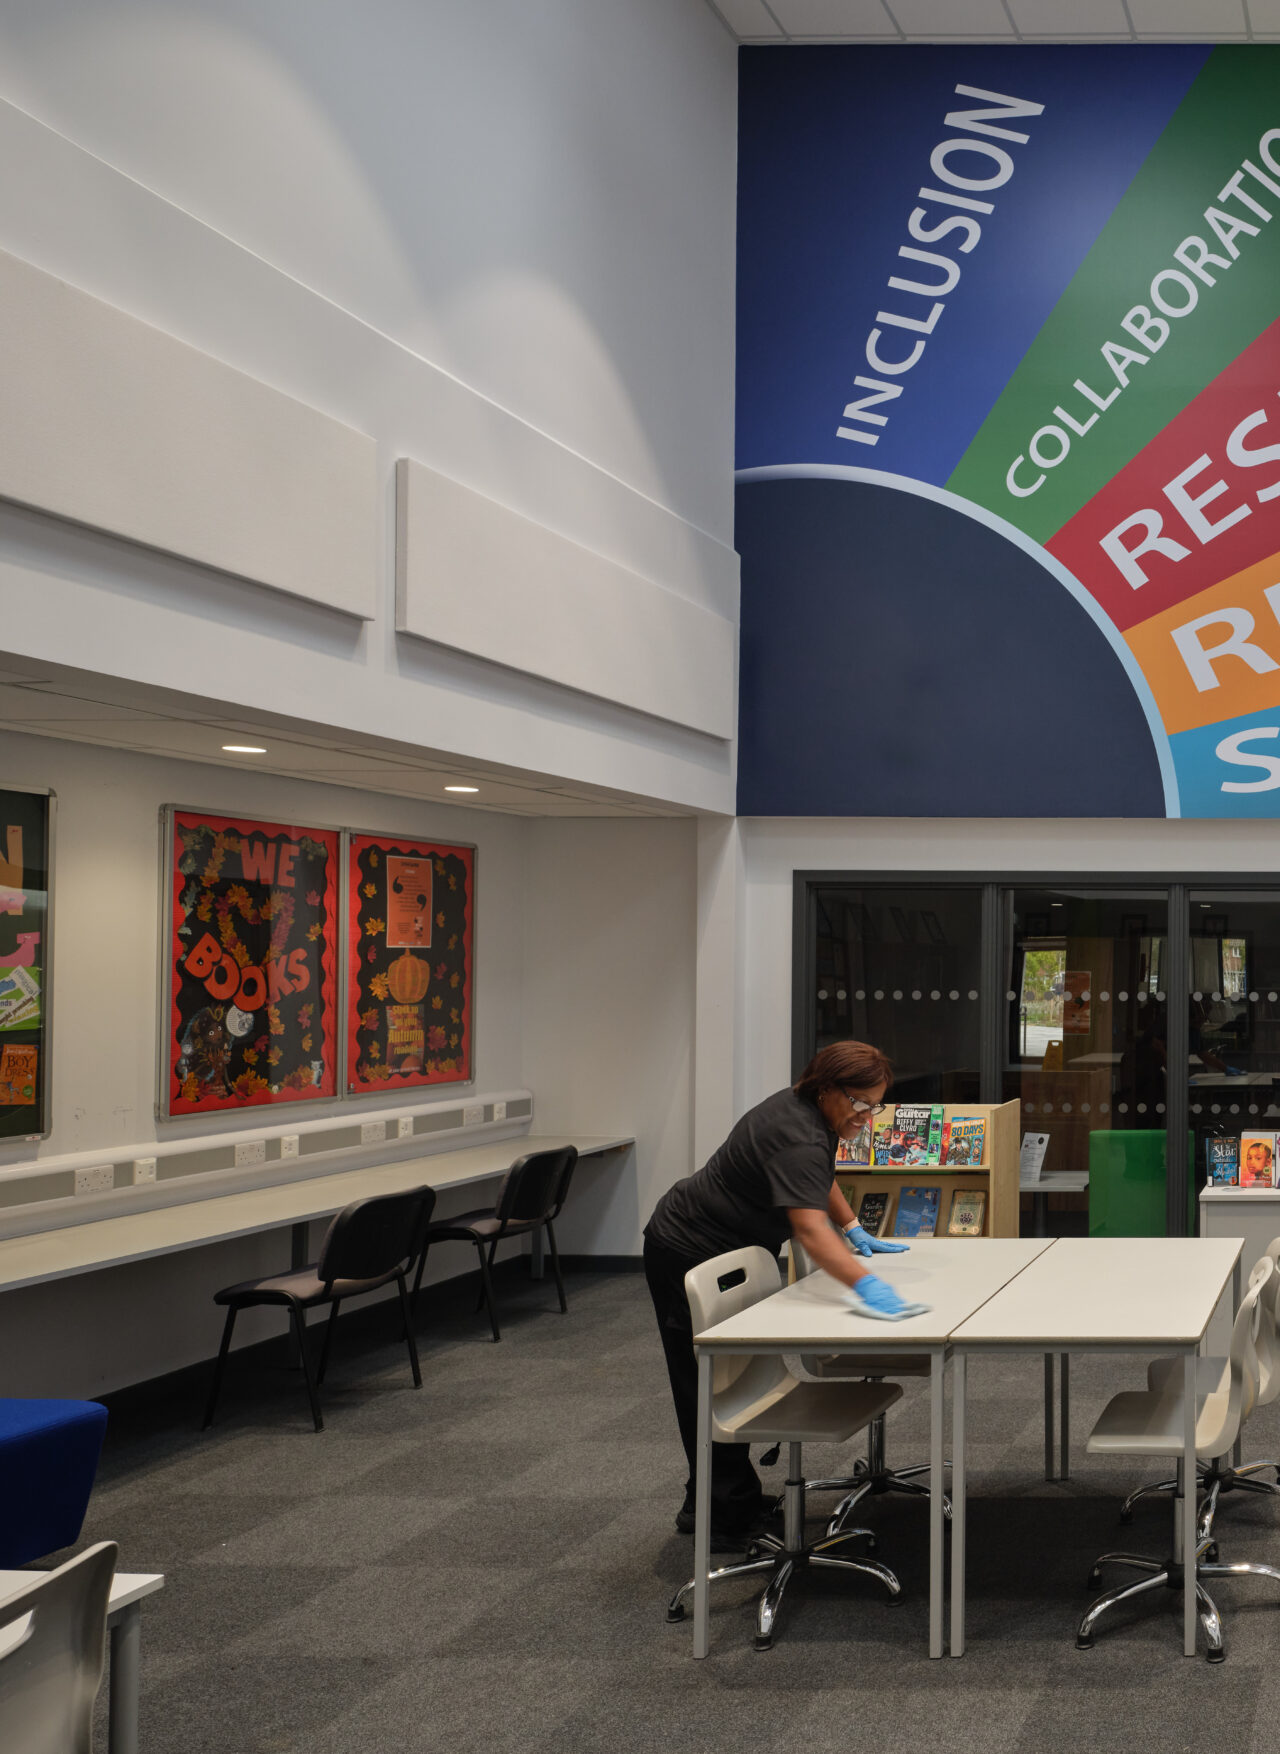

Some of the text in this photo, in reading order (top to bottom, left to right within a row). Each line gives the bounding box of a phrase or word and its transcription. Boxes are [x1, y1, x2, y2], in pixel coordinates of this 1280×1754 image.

[836, 83, 1046, 446] INCLUSION
[240, 838, 300, 888] WE
[184, 932, 311, 1012] BOOKS
[388, 1029, 424, 1044] Autumn
[8, 1055, 33, 1068] BOY
[895, 1108, 931, 1119] Guitar
[951, 1124, 984, 1137] 80 DAYS
